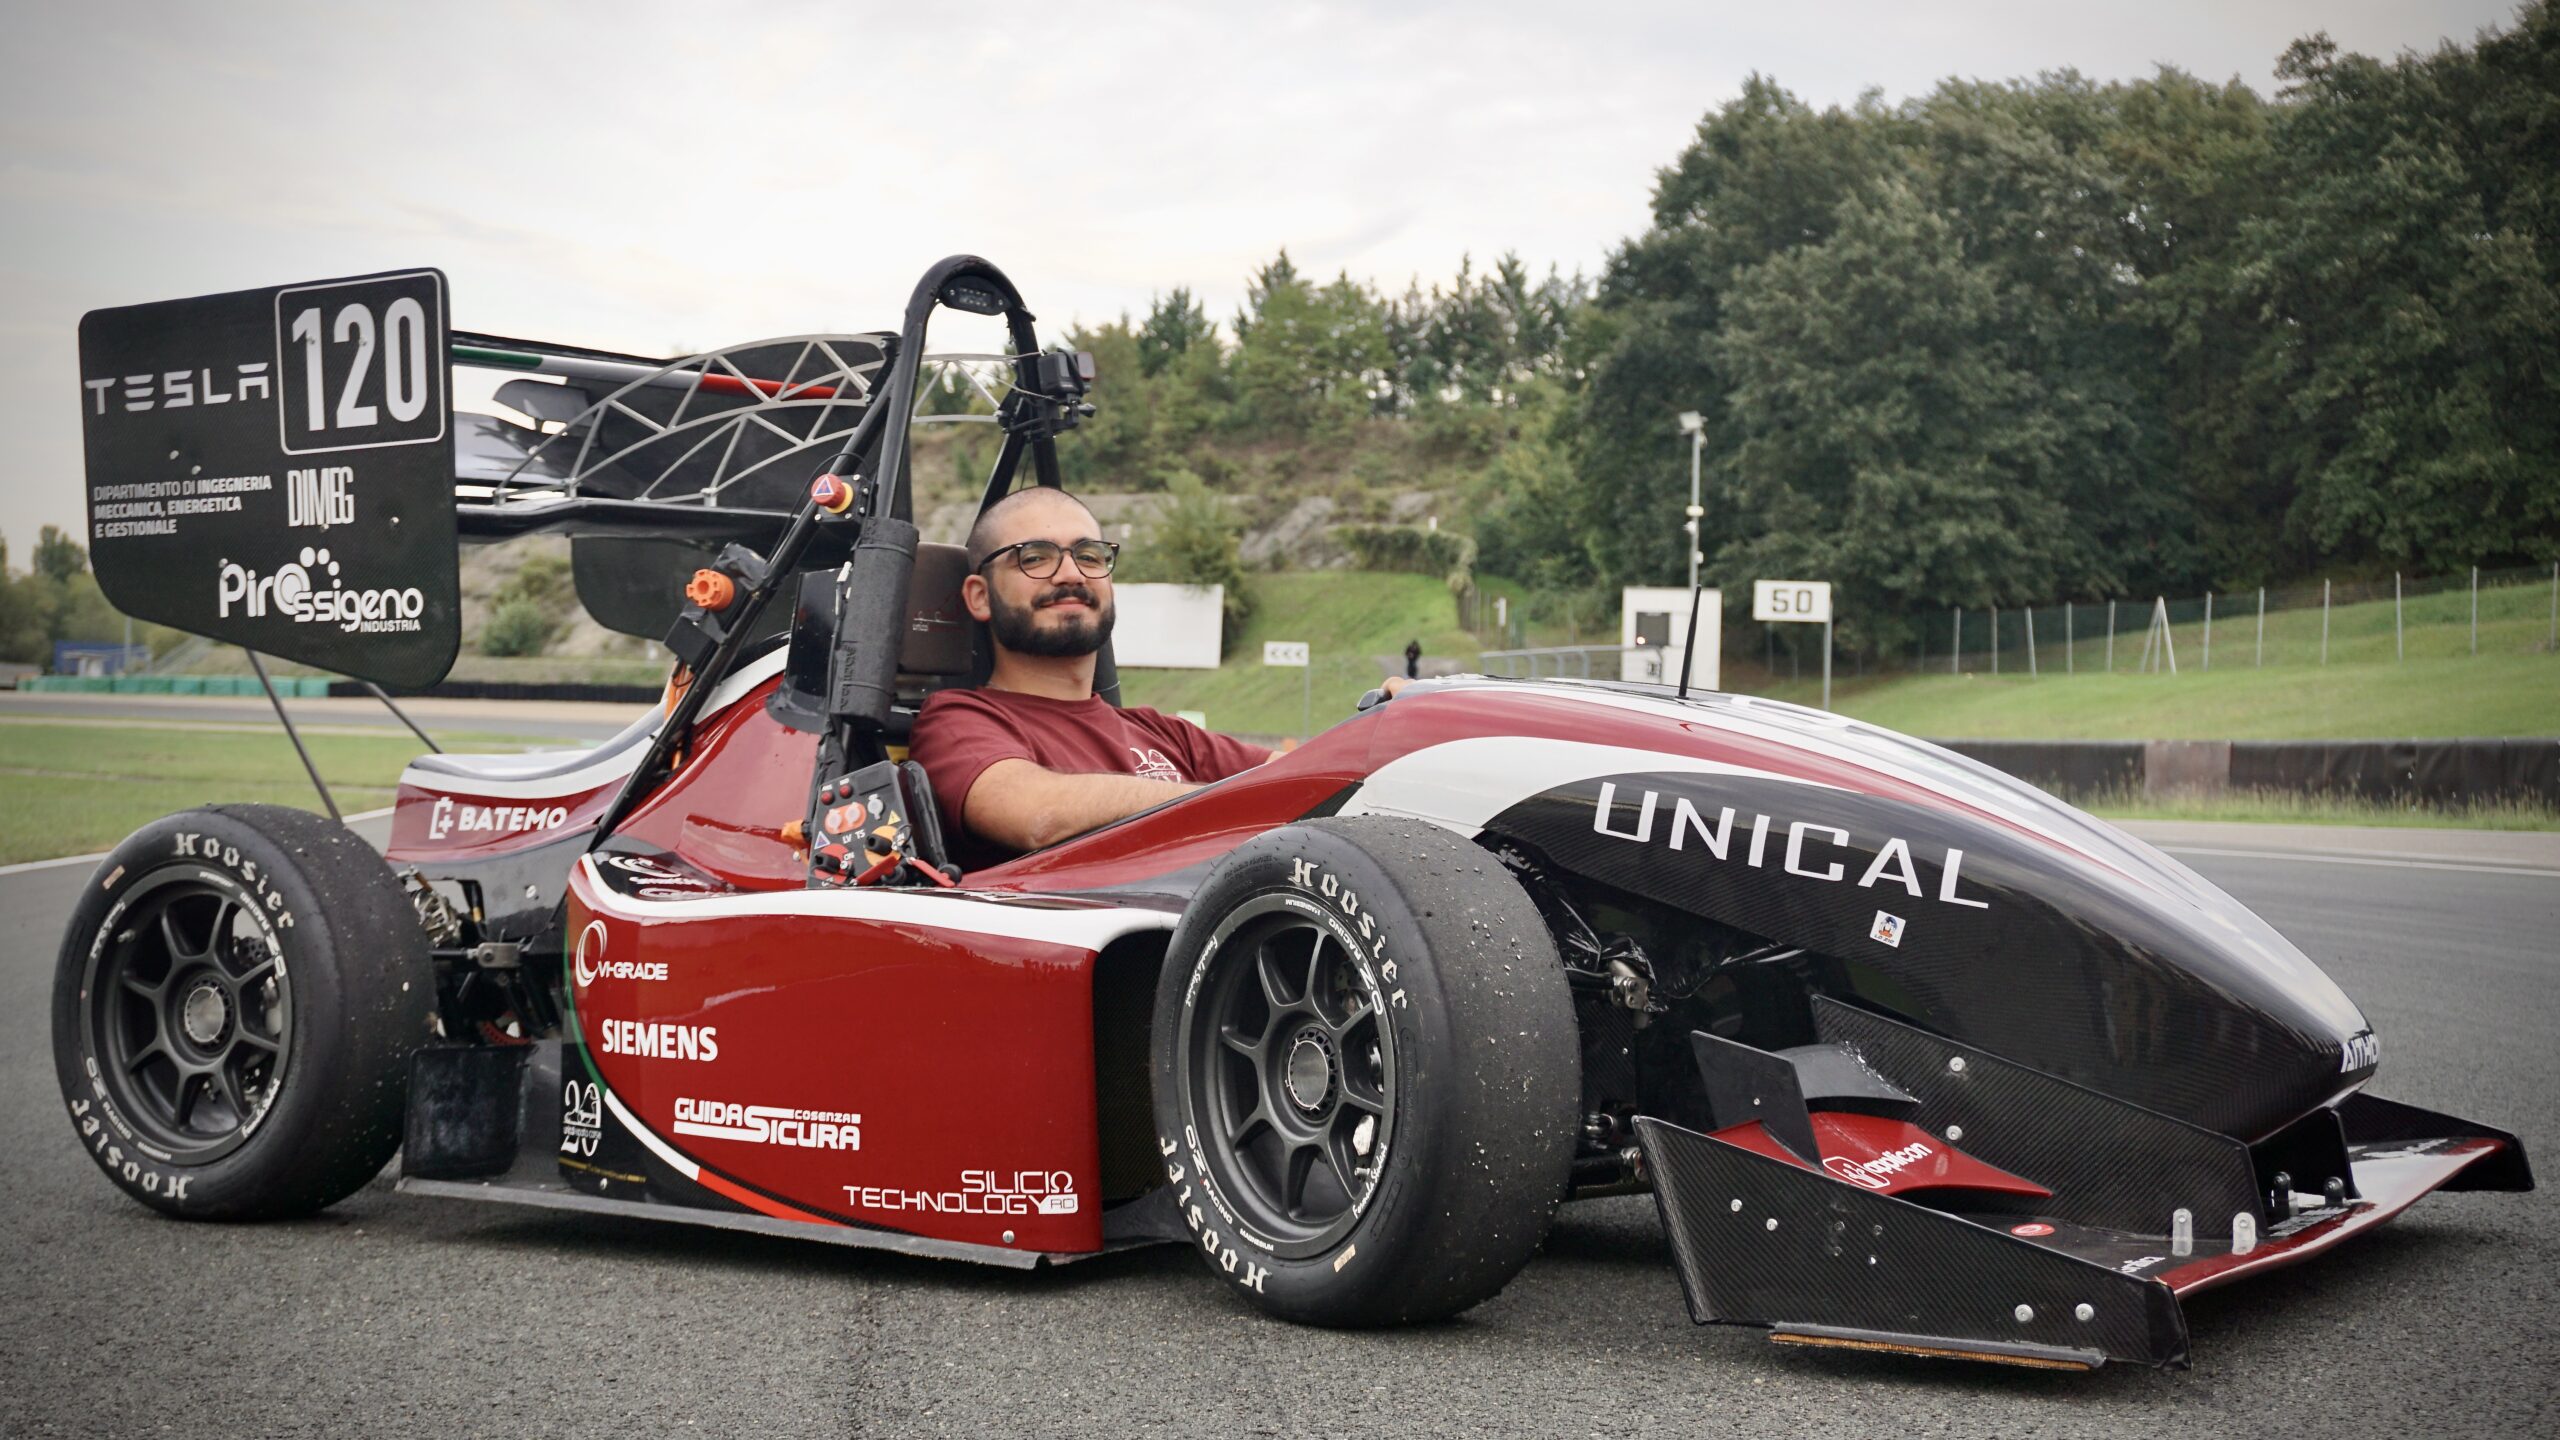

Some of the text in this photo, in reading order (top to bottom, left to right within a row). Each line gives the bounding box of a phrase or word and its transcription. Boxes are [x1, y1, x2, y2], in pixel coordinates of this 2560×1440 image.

[292, 297, 428, 432] 120
[84, 362, 270, 415] TESLA
[93, 475, 273, 502] DIPARTIMENTO DI INGEGNERIA
[94, 496, 243, 520] MECCANICA, ENERGETICA
[287, 466, 355, 528] DIMEG
[94, 519, 178, 539] E GESTIONALE
[1772, 588, 1813, 613] 50
[360, 619, 422, 633] INDUSTRIA
[457, 806, 569, 832] BATEMO
[1594, 781, 1990, 910] UNICAL
[173, 832, 295, 929] Hoosier
[1287, 857, 1408, 1010] Hoosier
[1328, 917, 1363, 961] RACING
[597, 960, 669, 981] VI-GRADE
[602, 1018, 719, 1062] SIEMENS
[71, 1100, 195, 1200] Hoosier
[1862, 1142, 1933, 1175] applicon
[842, 1184, 1053, 1215] TECHNOLOGY
[1160, 1136, 1274, 1295] Hoosier
[1203, 1178, 1233, 1225] RACING
